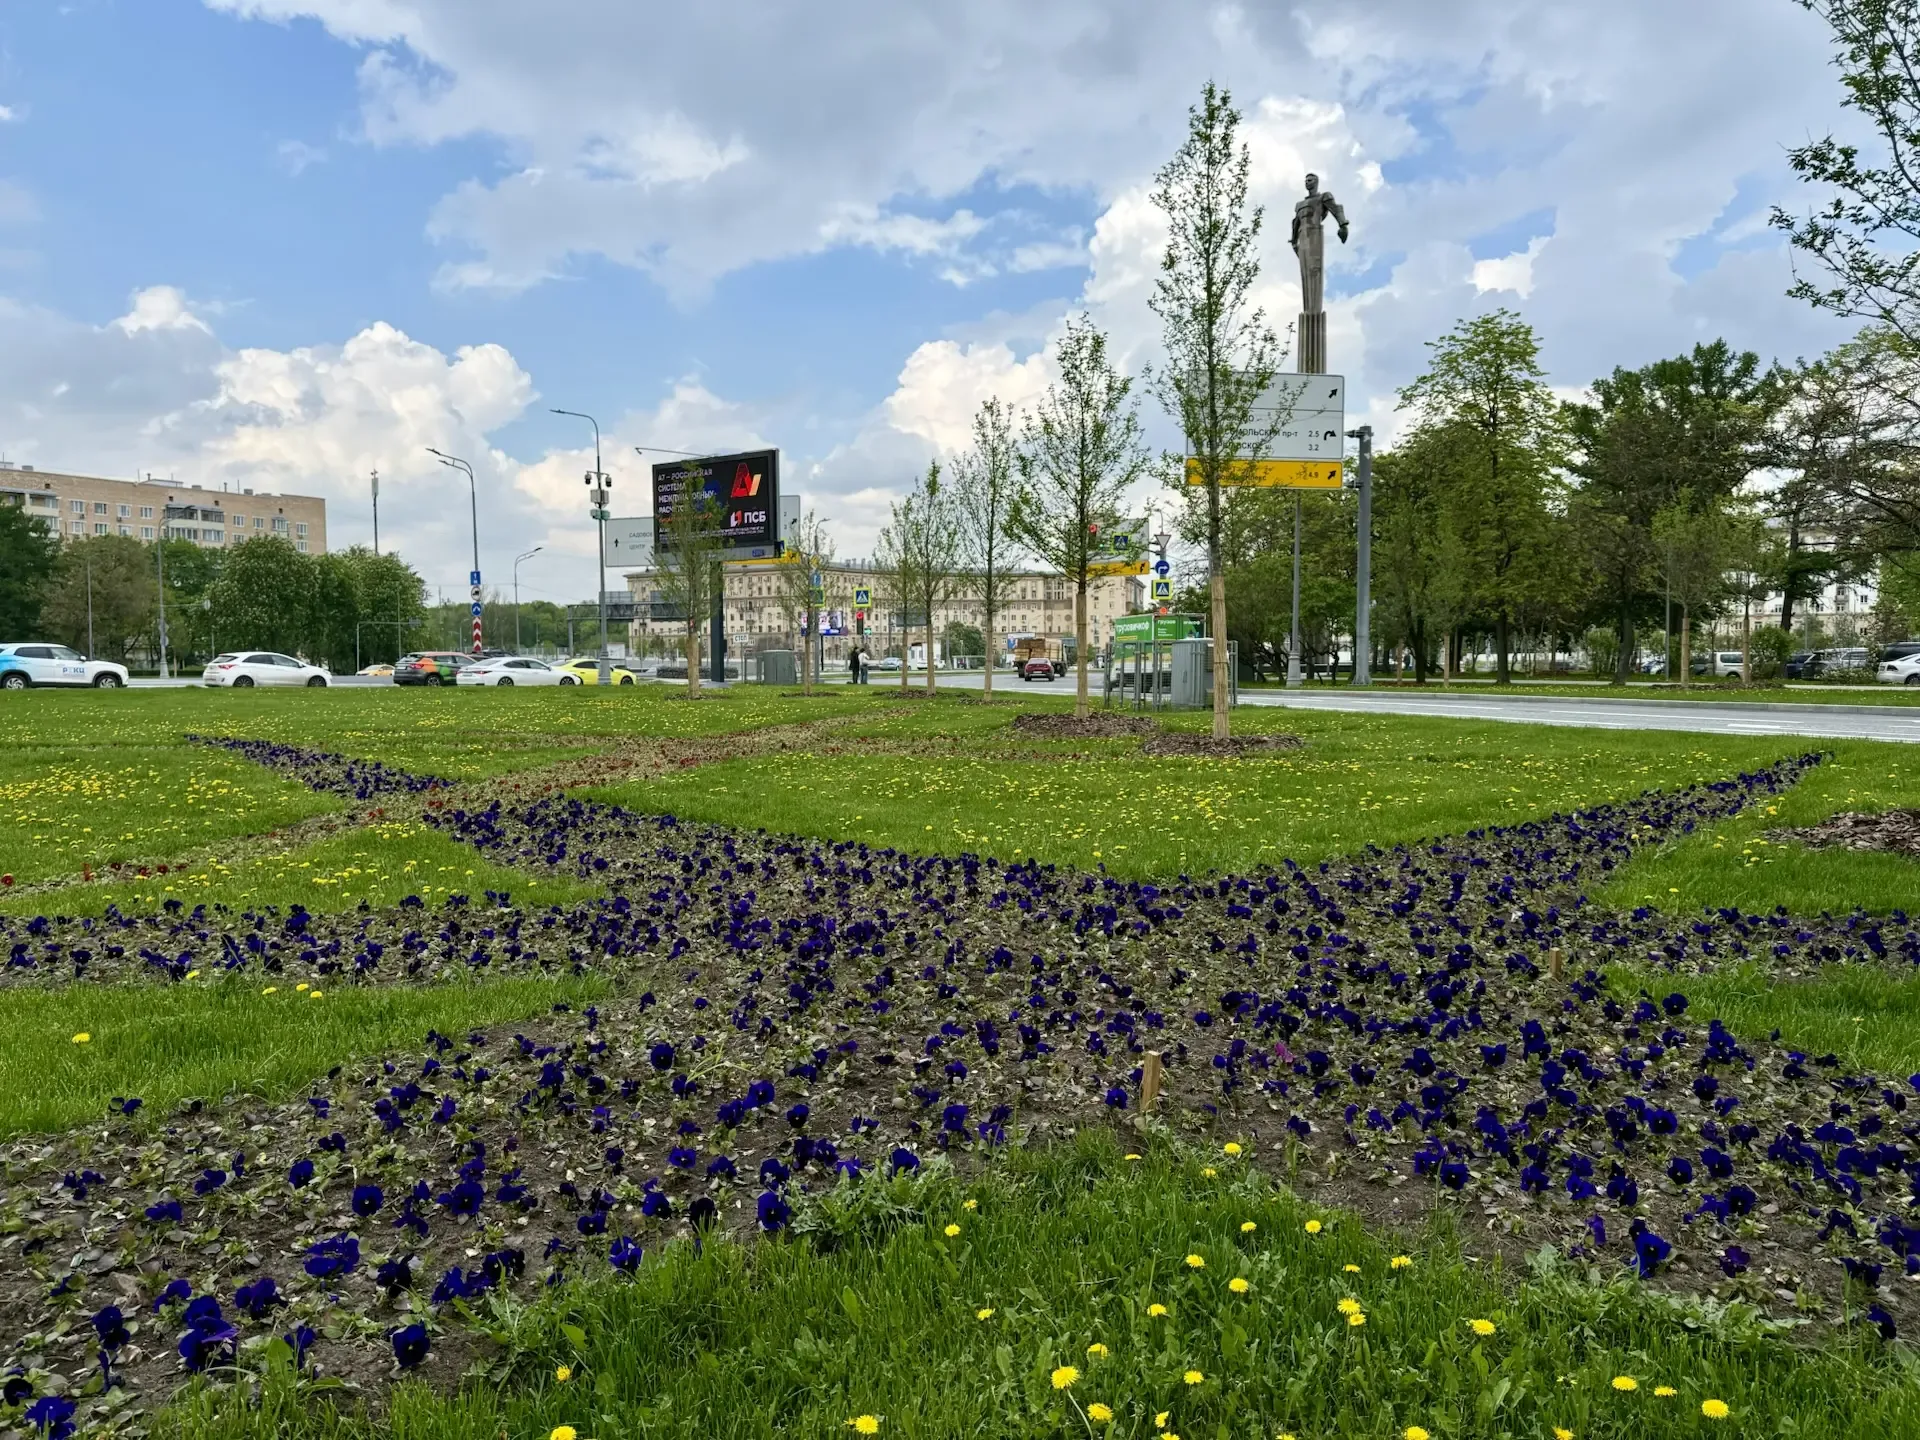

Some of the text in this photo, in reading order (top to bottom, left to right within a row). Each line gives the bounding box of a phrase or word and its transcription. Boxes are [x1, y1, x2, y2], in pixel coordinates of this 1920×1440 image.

[1308, 430, 1320, 438] 2.5
[1308, 444, 1320, 452] 3.2
[744, 510, 767, 524] ПСБ
